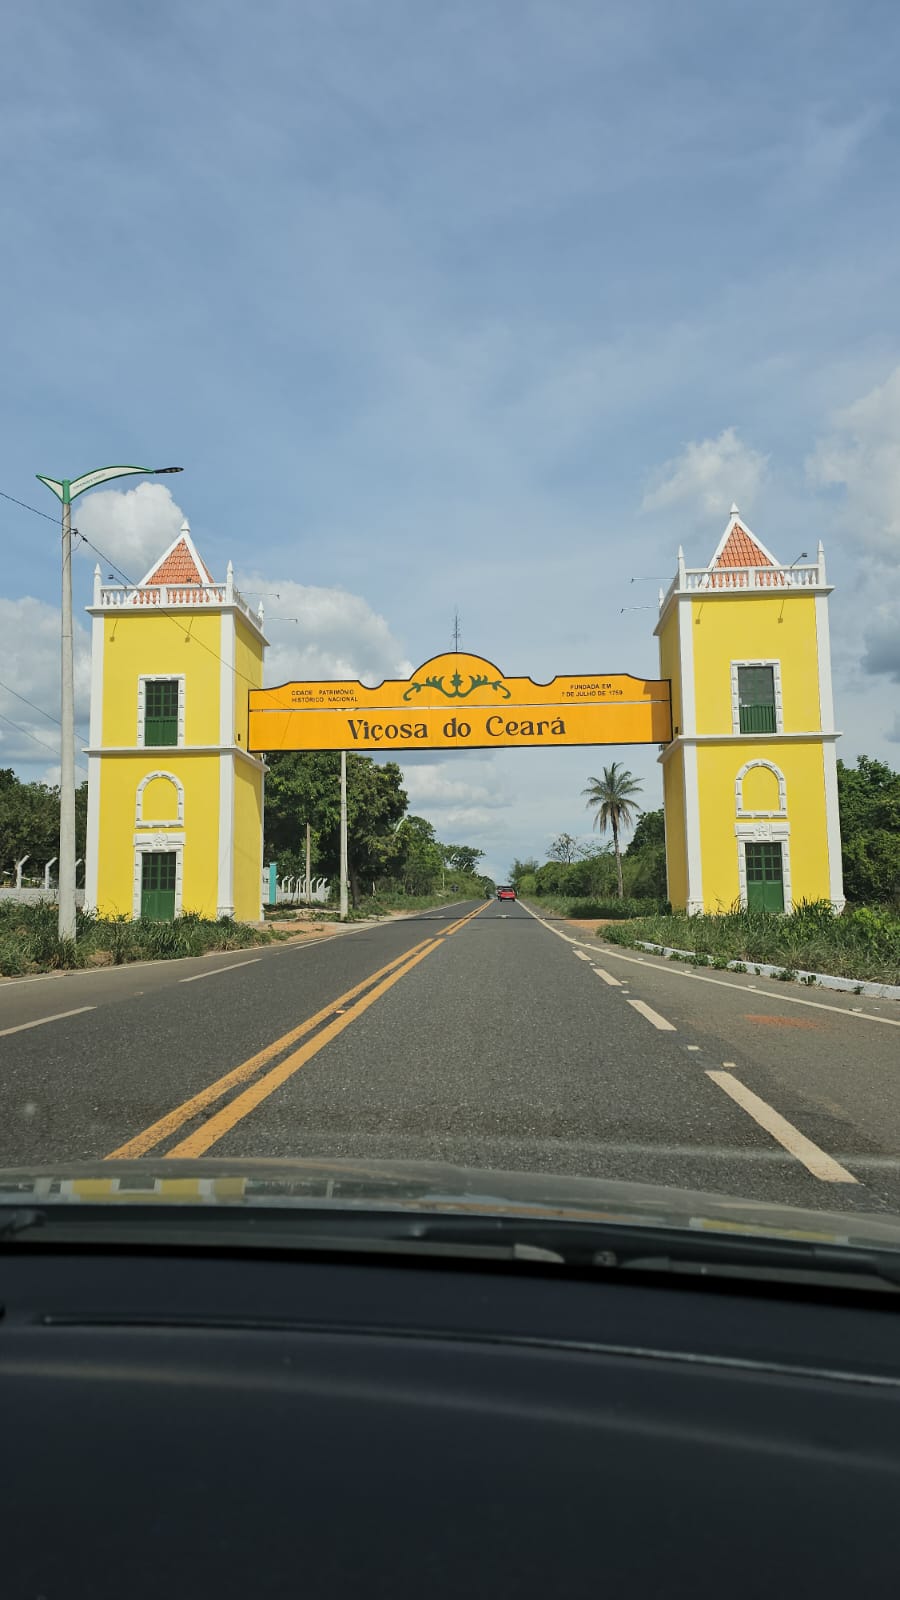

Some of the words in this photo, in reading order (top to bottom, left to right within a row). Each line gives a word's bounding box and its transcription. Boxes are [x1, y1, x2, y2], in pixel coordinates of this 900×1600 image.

[347, 719, 428, 741] Viçosa
[443, 718, 471, 738] do
[485, 715, 566, 737] Ceará
